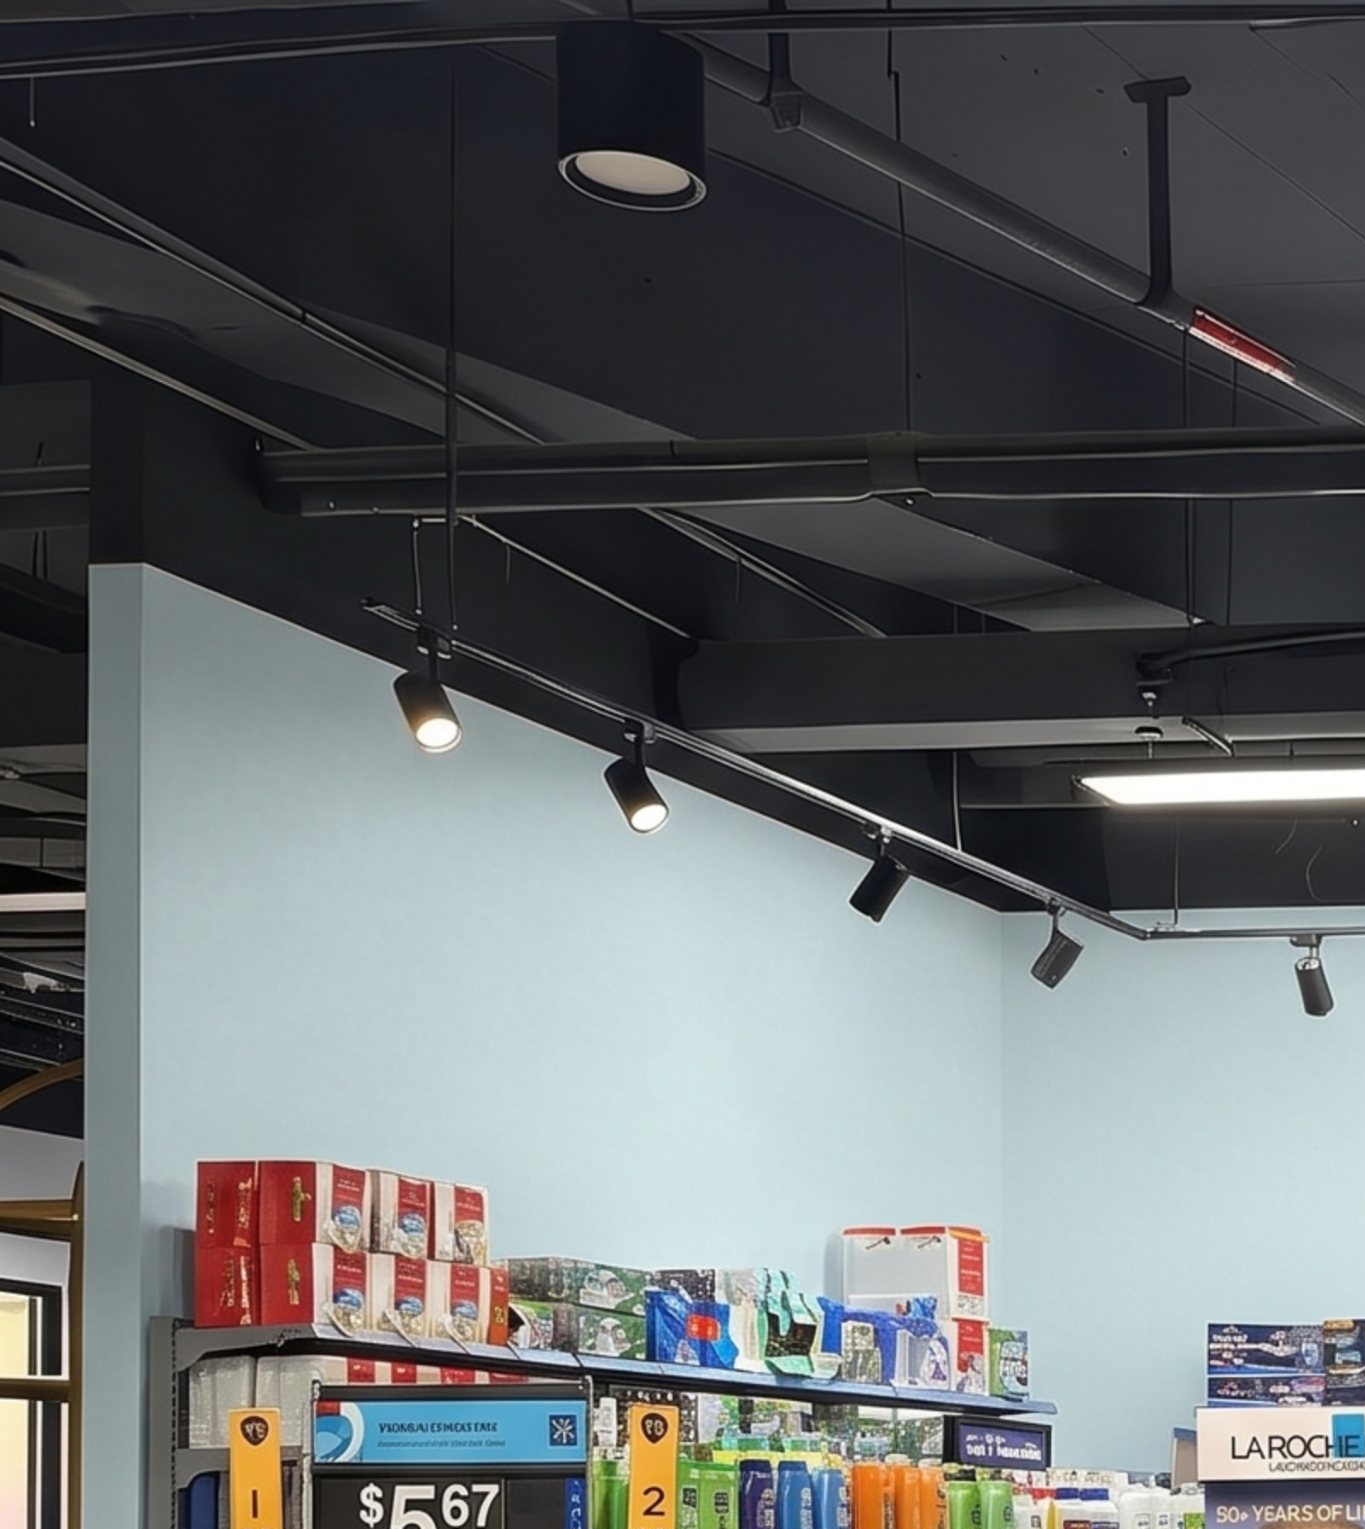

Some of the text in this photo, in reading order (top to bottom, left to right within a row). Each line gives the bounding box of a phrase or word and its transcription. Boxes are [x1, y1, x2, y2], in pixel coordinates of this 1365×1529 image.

[643, 1486, 666, 1516] 2
[1252, 1504, 1314, 1522] YEARS
[1316, 1504, 1344, 1521] OF
